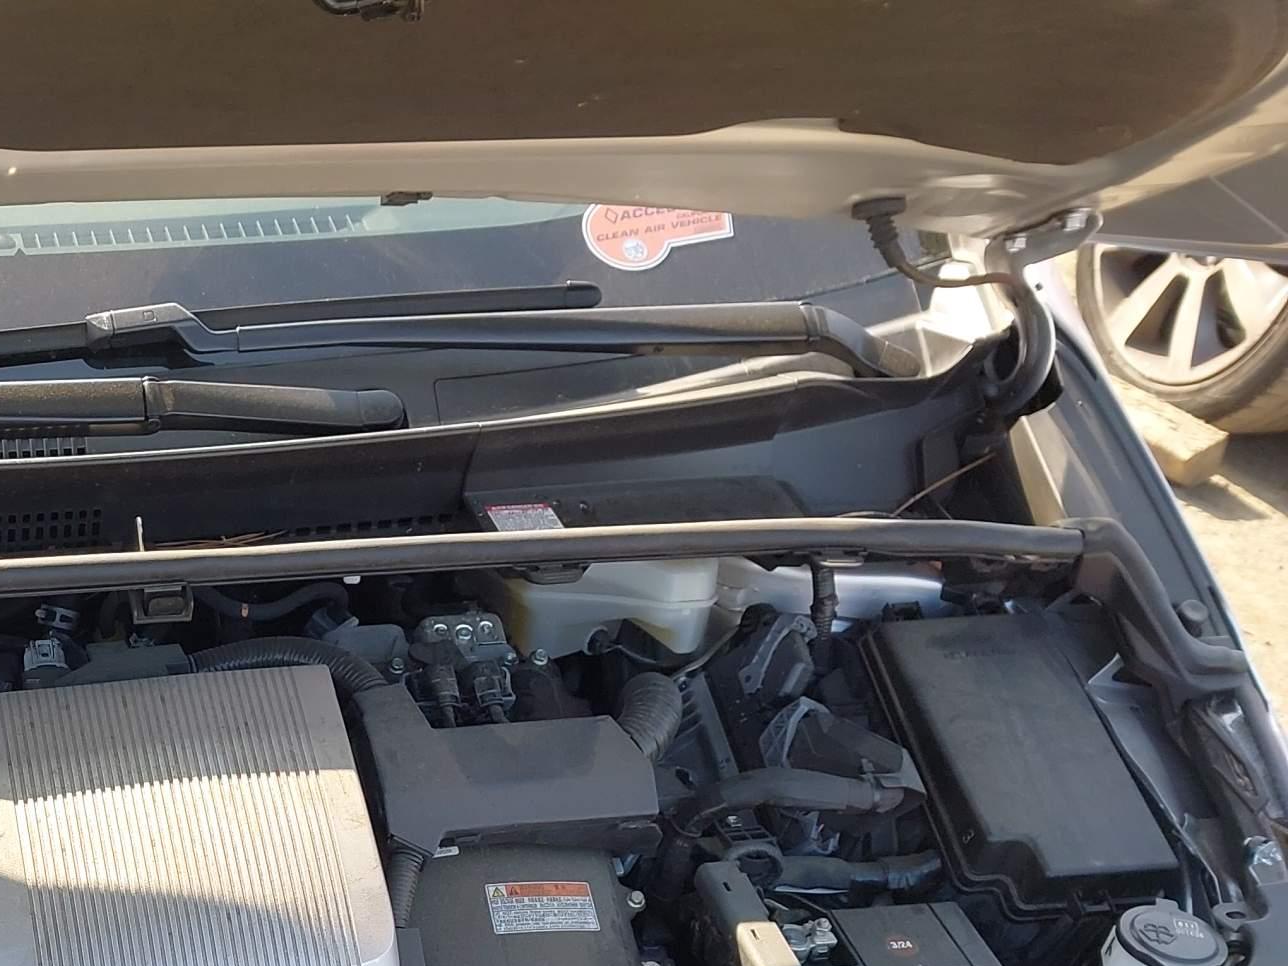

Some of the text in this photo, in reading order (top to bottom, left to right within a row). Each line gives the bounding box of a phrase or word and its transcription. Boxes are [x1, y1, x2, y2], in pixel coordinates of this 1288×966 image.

[596, 228, 640, 242] CLEAN
[644, 224, 665, 234] AIR
[671, 214, 722, 229] VEHICLE
